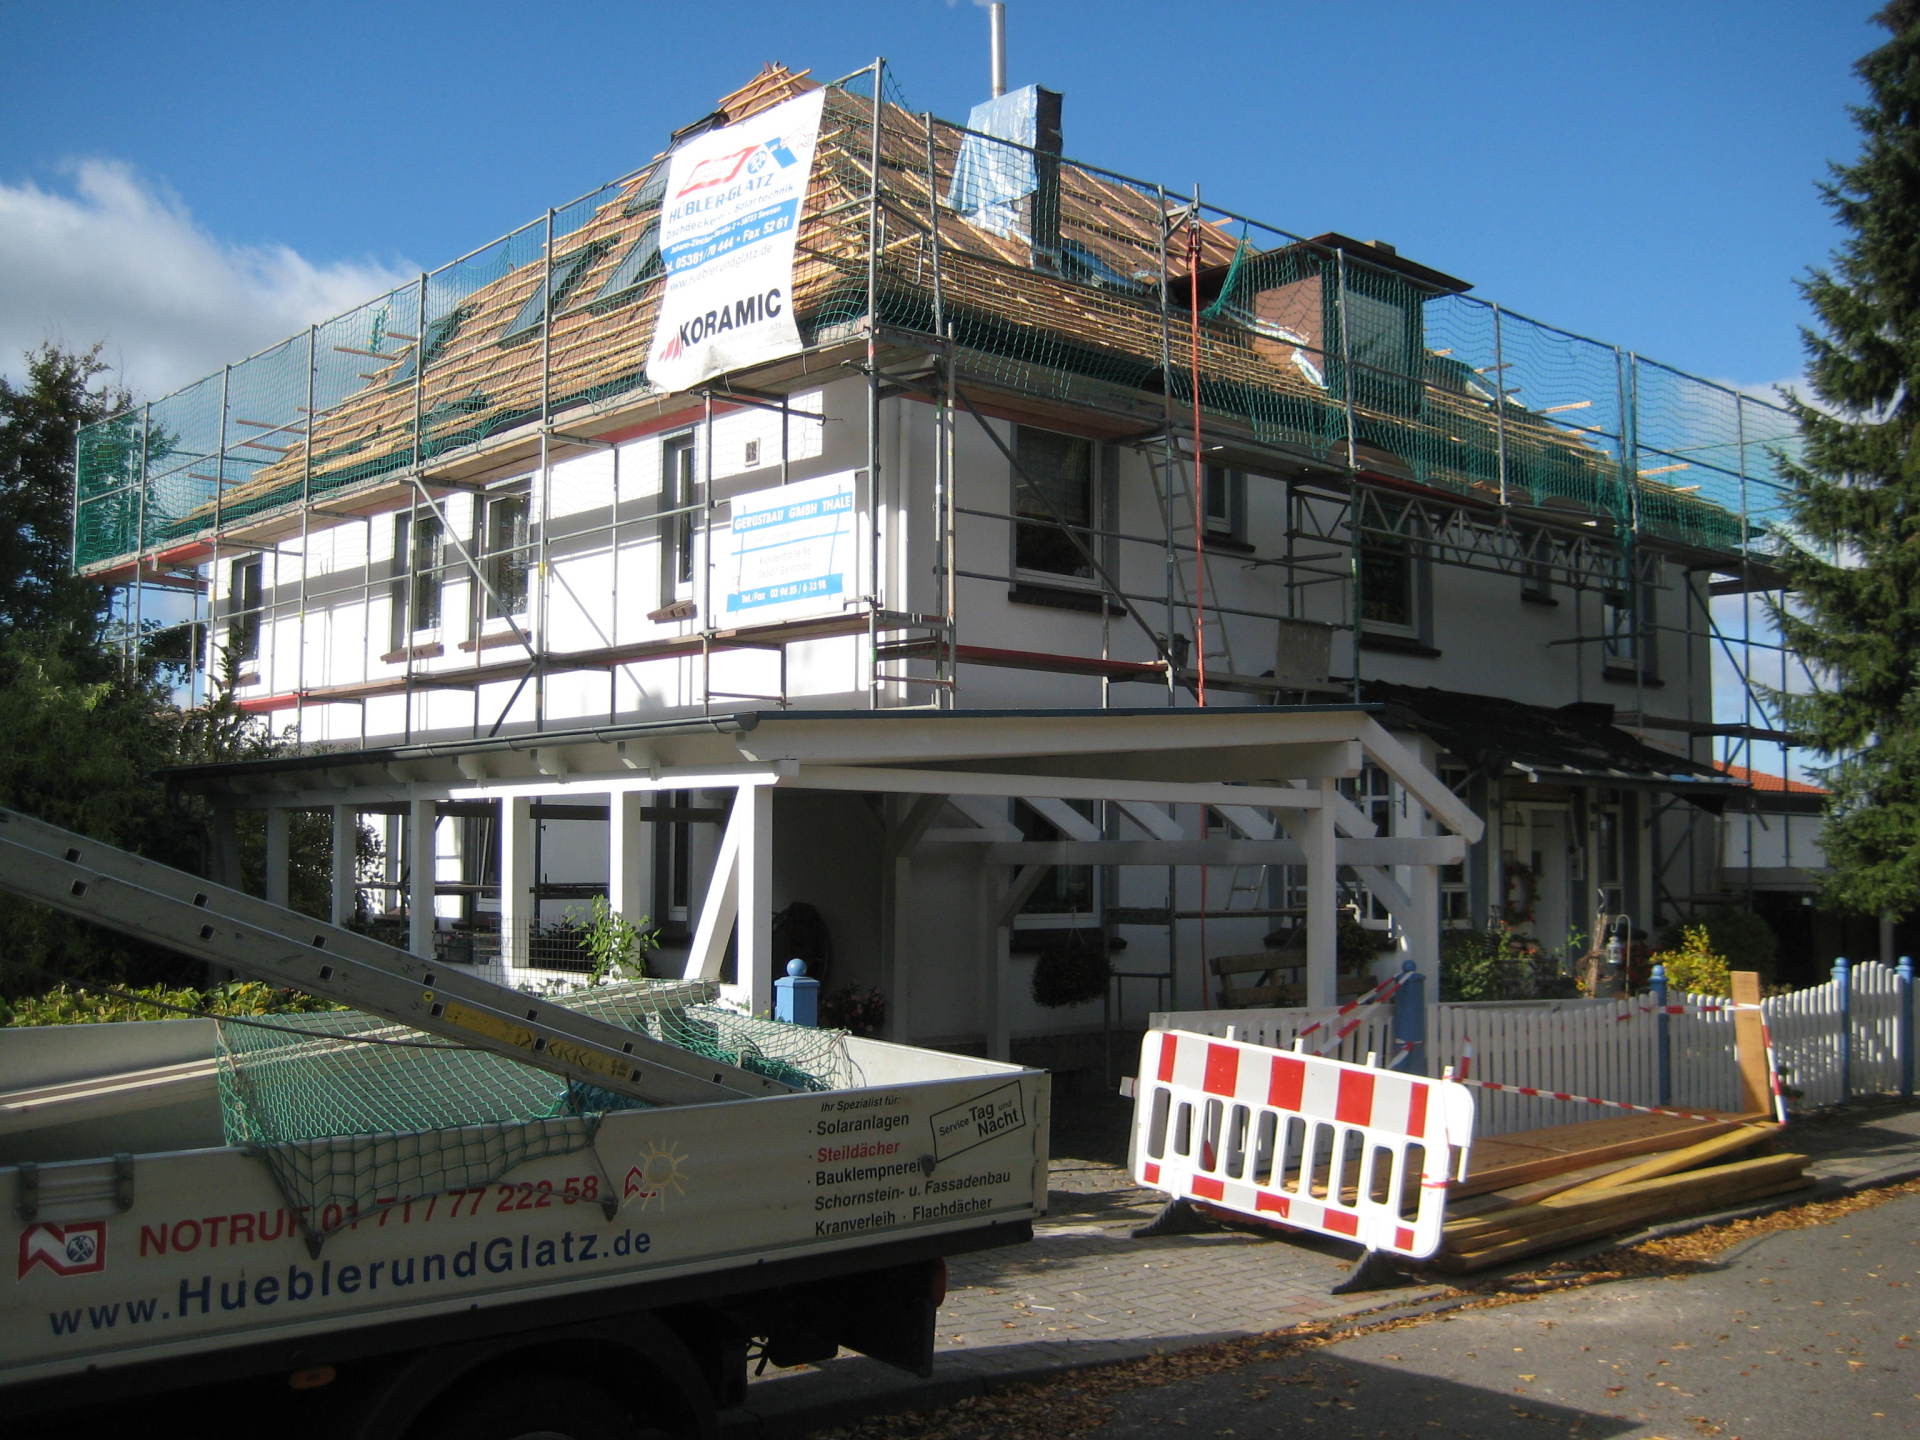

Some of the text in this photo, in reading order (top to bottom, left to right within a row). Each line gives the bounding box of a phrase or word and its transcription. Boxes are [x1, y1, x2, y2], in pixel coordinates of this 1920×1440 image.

[742, 228, 761, 242] Fax
[680, 288, 782, 349] KORAMIC
[822, 495, 851, 512] THALE
[821, 1096, 901, 1112] Ihr Spezialist für:
[939, 1100, 1012, 1136] Service Tag und
[817, 1113, 909, 1136] Solaranlagen
[977, 1108, 1019, 1137] Nacht
[817, 1140, 901, 1163] Steildächer
[816, 1159, 921, 1186] Bauklempnerei
[815, 1171, 1011, 1211] Schornstein- u. Fassadenbau
[140, 1205, 310, 1257] NOTRUF
[449, 1187, 487, 1218] 77
[496, 1180, 553, 1212] 222
[563, 1176, 599, 1205] 58
[815, 1197, 993, 1236] Kranverleih Flachdächer
[50, 1229, 651, 1336] www.HueblerundGlatz.de
